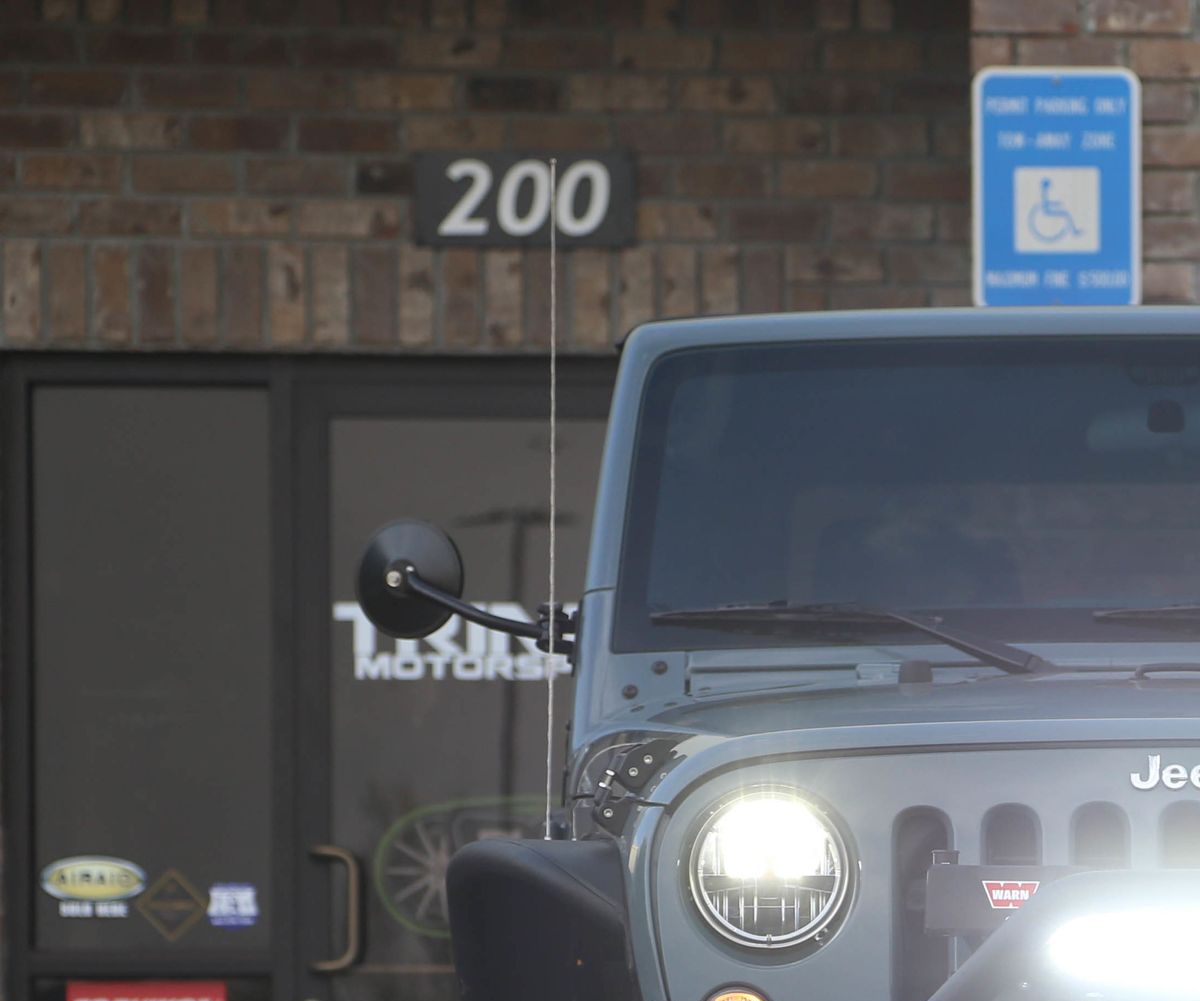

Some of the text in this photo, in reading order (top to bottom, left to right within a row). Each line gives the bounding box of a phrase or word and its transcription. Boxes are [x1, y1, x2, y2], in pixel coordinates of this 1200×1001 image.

[437, 159, 611, 236] 200
[354, 653, 574, 680] MOTORSP
[992, 889, 1029, 900] WARN
